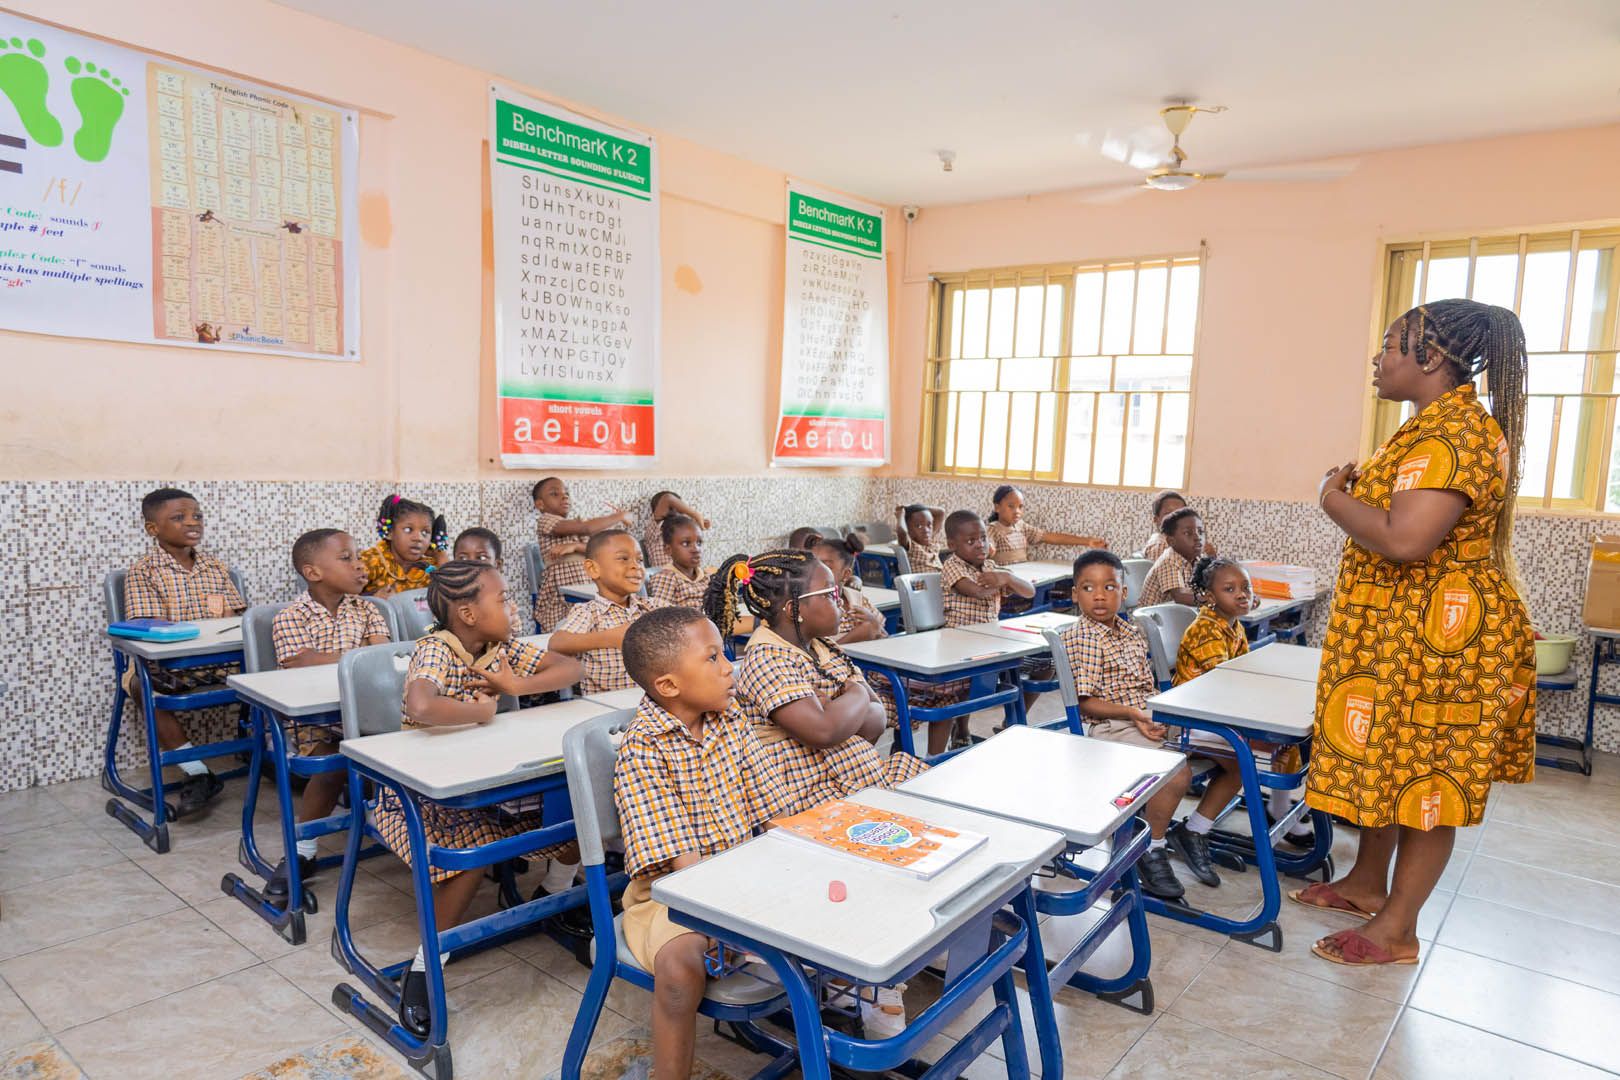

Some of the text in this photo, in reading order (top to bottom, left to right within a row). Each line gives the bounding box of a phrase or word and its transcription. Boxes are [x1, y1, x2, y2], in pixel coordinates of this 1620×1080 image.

[512, 112, 638, 167] BenchmarK K 2
[798, 199, 874, 235] BenchmarK K 3
[17, 264, 39, 275] has
[42, 269, 93, 283] multiple
[95, 276, 144, 290] spellings
[1416, 703, 1475, 724] CIS
